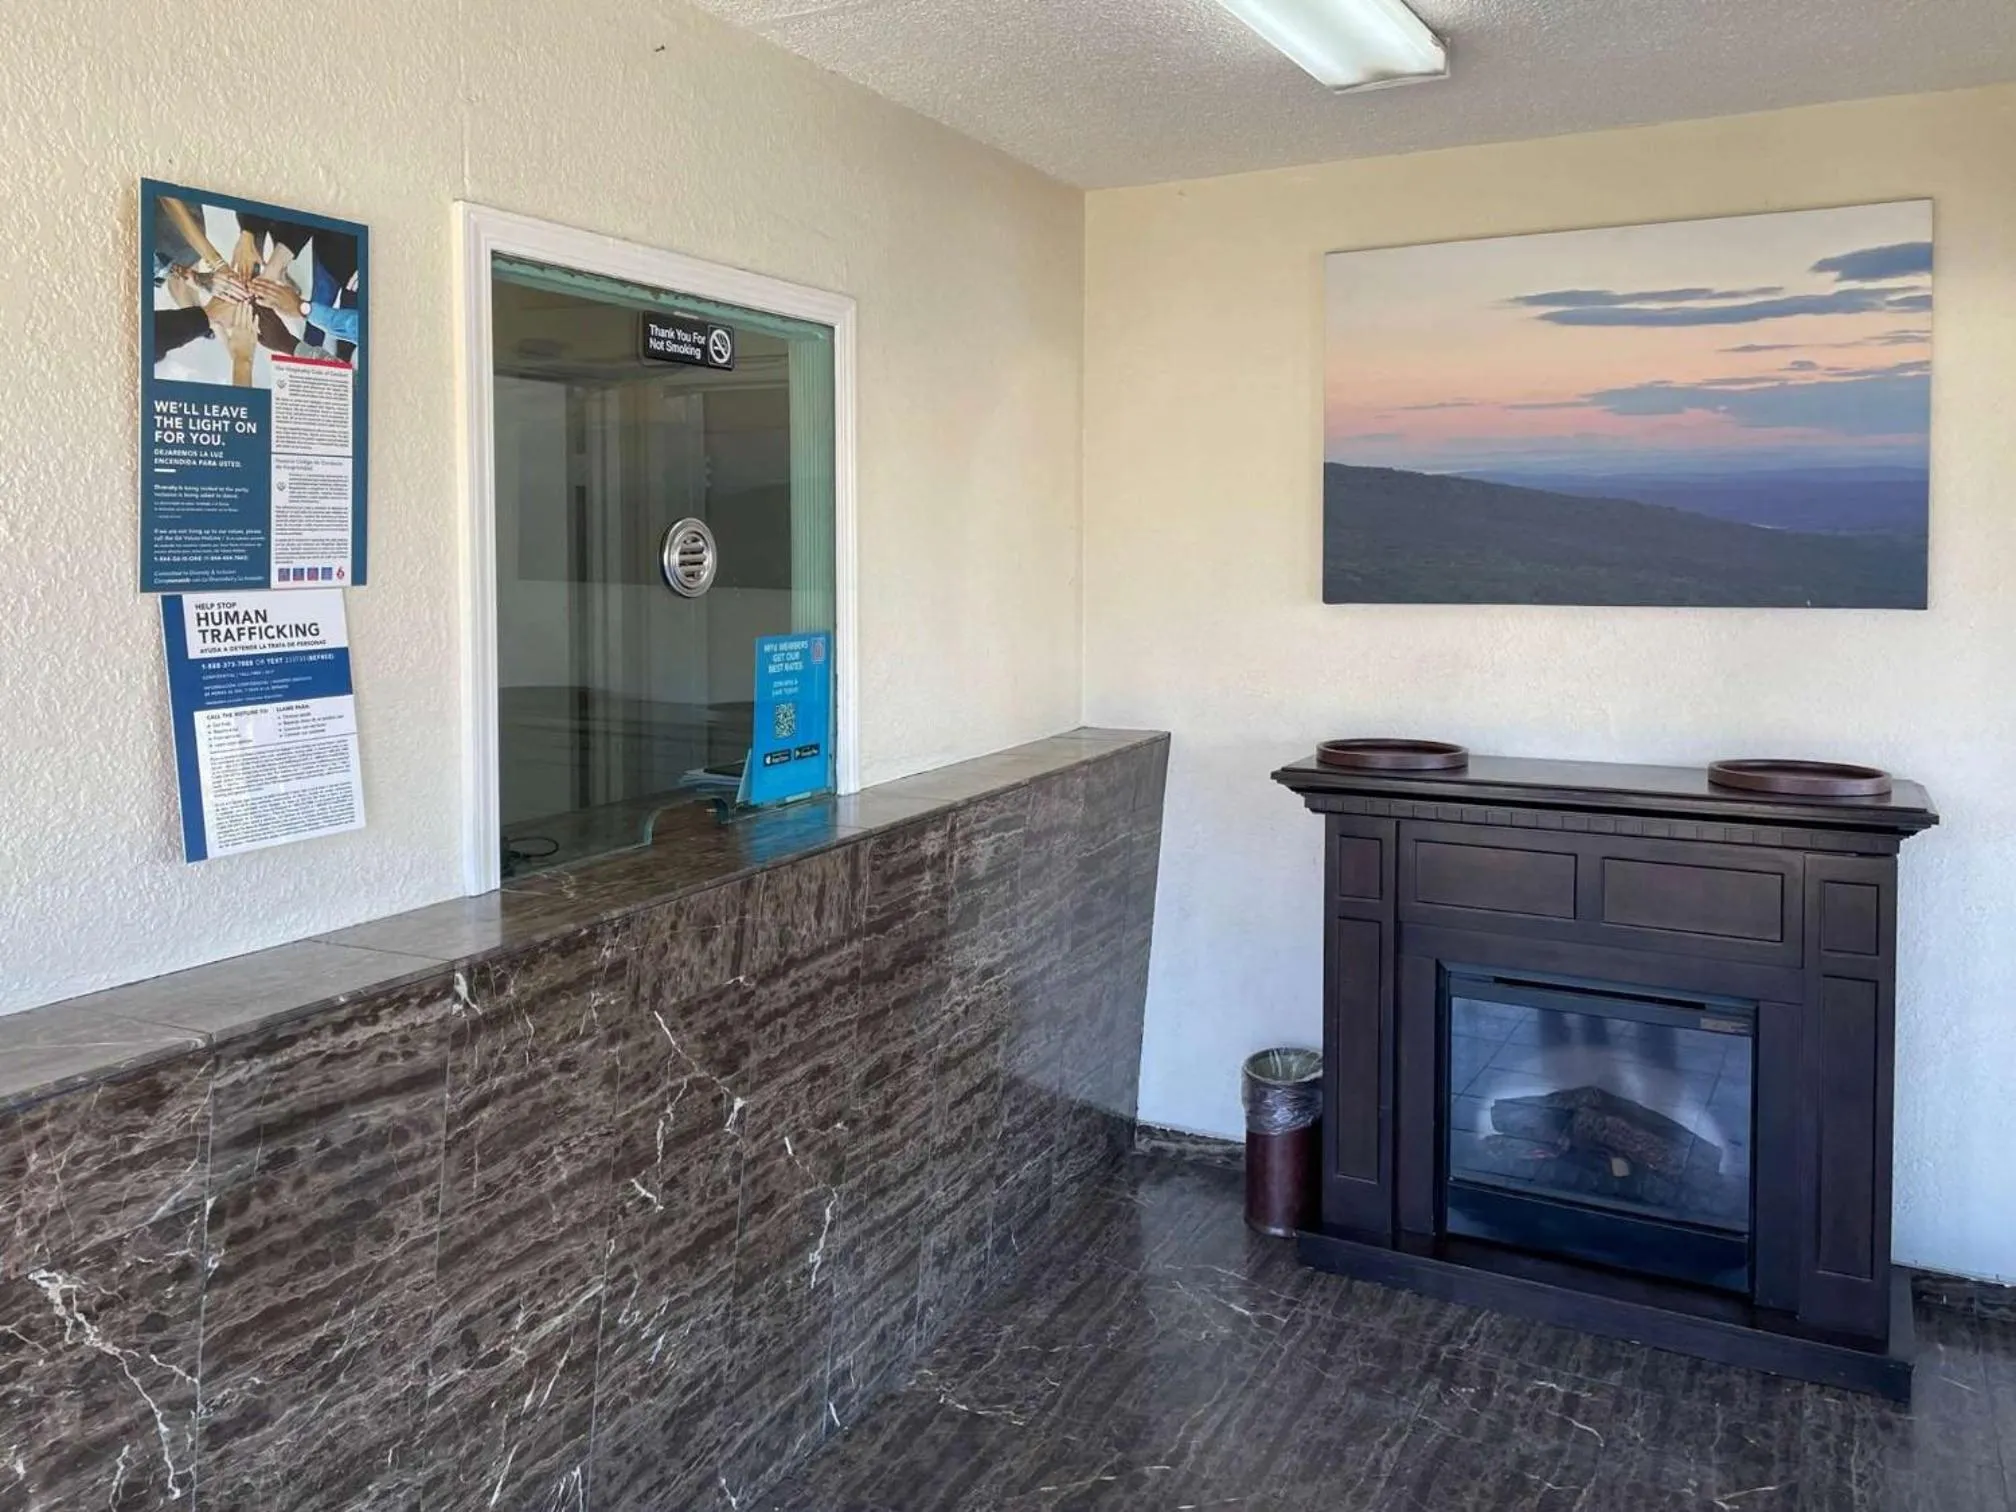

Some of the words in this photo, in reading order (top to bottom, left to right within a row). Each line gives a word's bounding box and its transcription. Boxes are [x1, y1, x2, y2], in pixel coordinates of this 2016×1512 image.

[649, 323, 674, 340] Thank
[676, 329, 691, 343] You
[693, 332, 706, 345] For
[649, 338, 665, 352] Not
[666, 341, 701, 360] Smoking
[154, 400, 199, 416] WE'LL
[204, 404, 248, 419] LEAVE
[154, 415, 183, 430] THE
[189, 418, 230, 432] LIGHT
[235, 421, 257, 434] ON
[154, 430, 185, 444] FOR
[190, 432, 226, 446] YOU.
[154, 448, 198, 457] DEJAREMOS
[154, 458, 197, 466] ENCENDIDA
[199, 459, 217, 467] PARA
[337, 566, 345, 580] 6
[195, 602, 215, 611] HELP
[217, 601, 237, 610] STOP
[196, 609, 268, 627] HUMAN
[198, 622, 320, 644] TRAFFICKING
[200, 647, 221, 655] AYUDA
[773, 652, 785, 662] GET
[786, 651, 800, 661] OUR
[266, 657, 283, 665] TEXT
[769, 663, 783, 674] BEST
